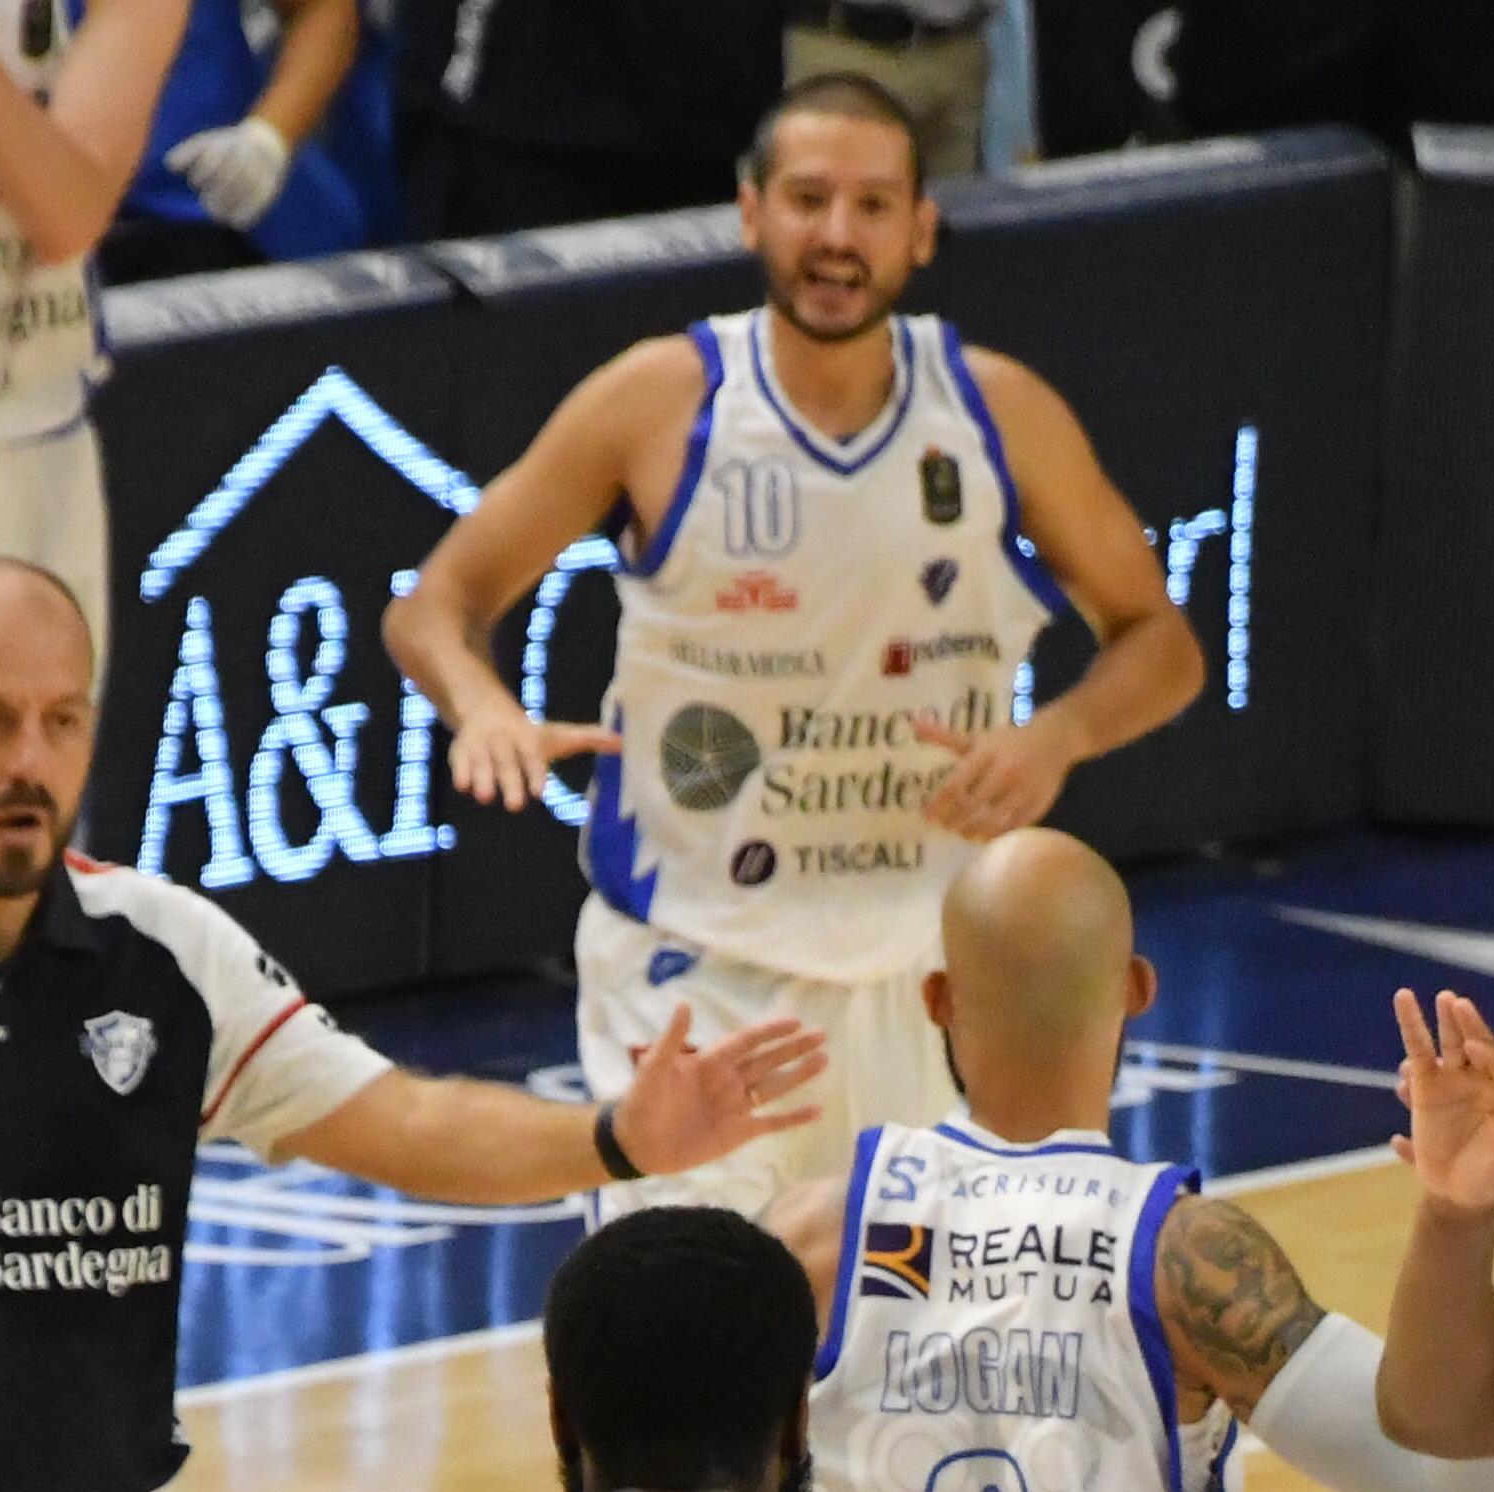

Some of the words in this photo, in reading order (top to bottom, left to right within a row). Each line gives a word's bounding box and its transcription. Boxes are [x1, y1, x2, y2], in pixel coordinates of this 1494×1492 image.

[710, 454, 804, 562] 10
[950, 687, 996, 733] di
[761, 758, 957, 816] Sarde
[794, 840, 925, 873] TISCALI
[122, 1183, 164, 1234] di
[948, 1222, 1118, 1273] REALE
[947, 1270, 1114, 1305] MUTUA
[879, 1326, 1084, 1421] LOGAN
